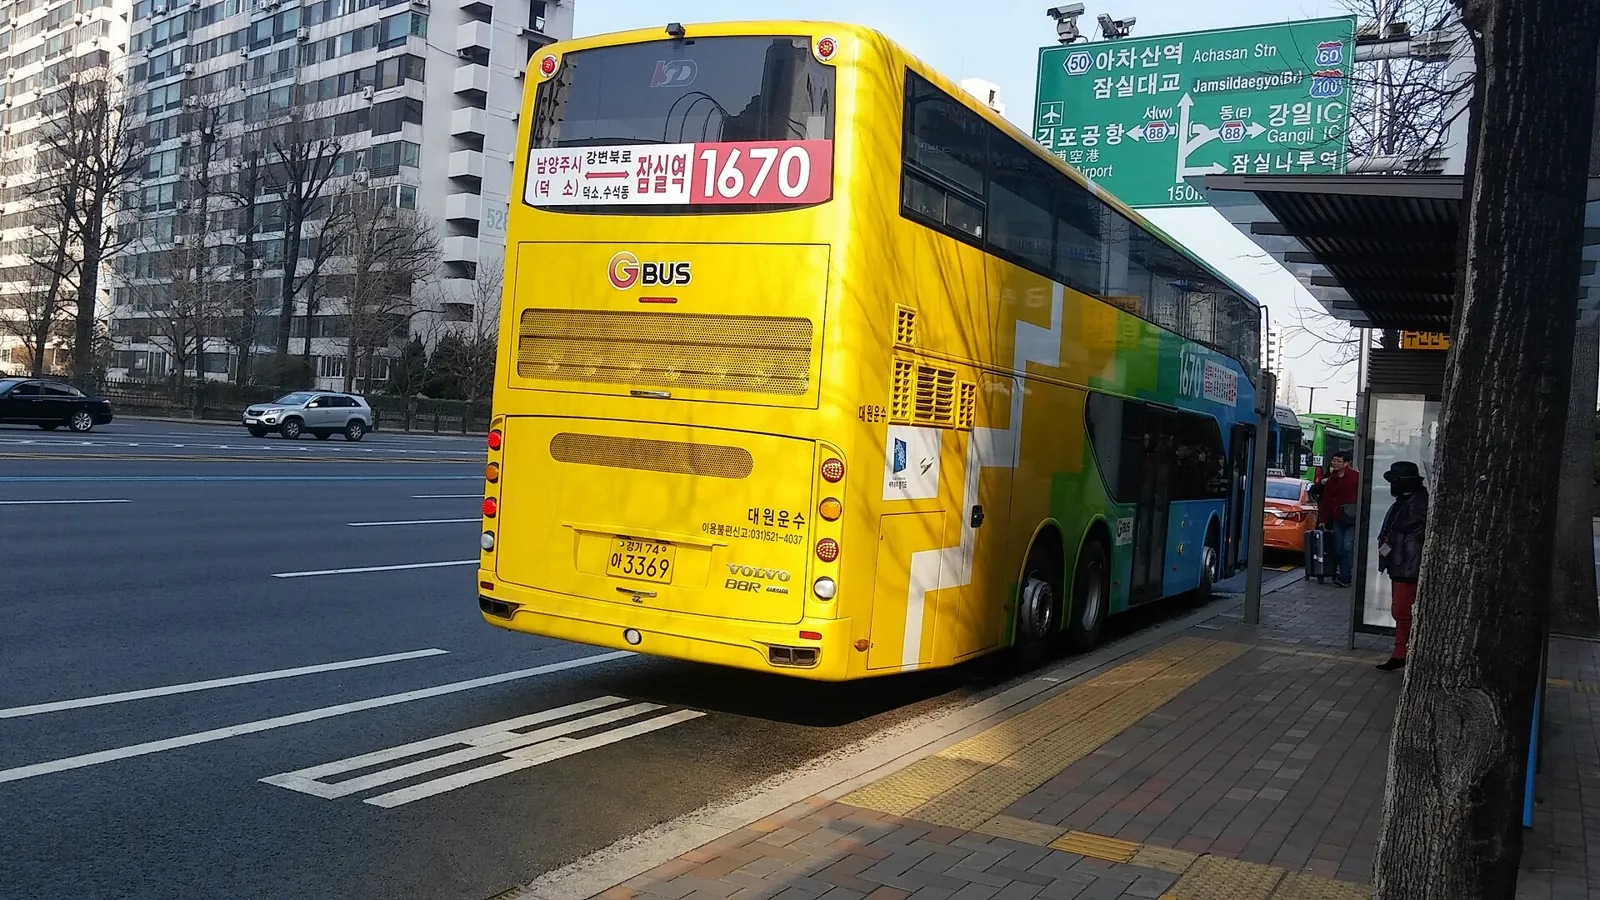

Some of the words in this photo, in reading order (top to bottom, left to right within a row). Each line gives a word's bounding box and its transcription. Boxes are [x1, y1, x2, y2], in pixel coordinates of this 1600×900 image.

[1070, 54, 1088, 71] 50
[1097, 42, 1184, 72] 아차산역
[1192, 47, 1249, 63] Achasan
[1254, 43, 1277, 58] Stn
[1320, 50, 1340, 63] 60
[1093, 73, 1180, 100] 잠실대교
[1316, 81, 1339, 95] 100
[1038, 122, 1125, 149] 김포공항
[1148, 127, 1164, 140] 88
[1224, 127, 1241, 140] 88
[1267, 127, 1314, 145] Gangil
[1323, 124, 1340, 140] IC
[536, 155, 583, 175] 남양주시
[586, 150, 632, 165] 강변북로
[1232, 151, 1338, 174] 잠실나루역
[636, 154, 687, 194] 잠실역
[699, 146, 811, 198] 1670
[1179, 347, 1201, 399] 1670
[858, 404, 887, 423] 대원운수
[748, 507, 806, 531] 대원운수
[626, 541, 642, 553] 경기
[645, 543, 660, 555] 74
[726, 563, 791, 582] VOLVO
[725, 579, 761, 593] B8R
